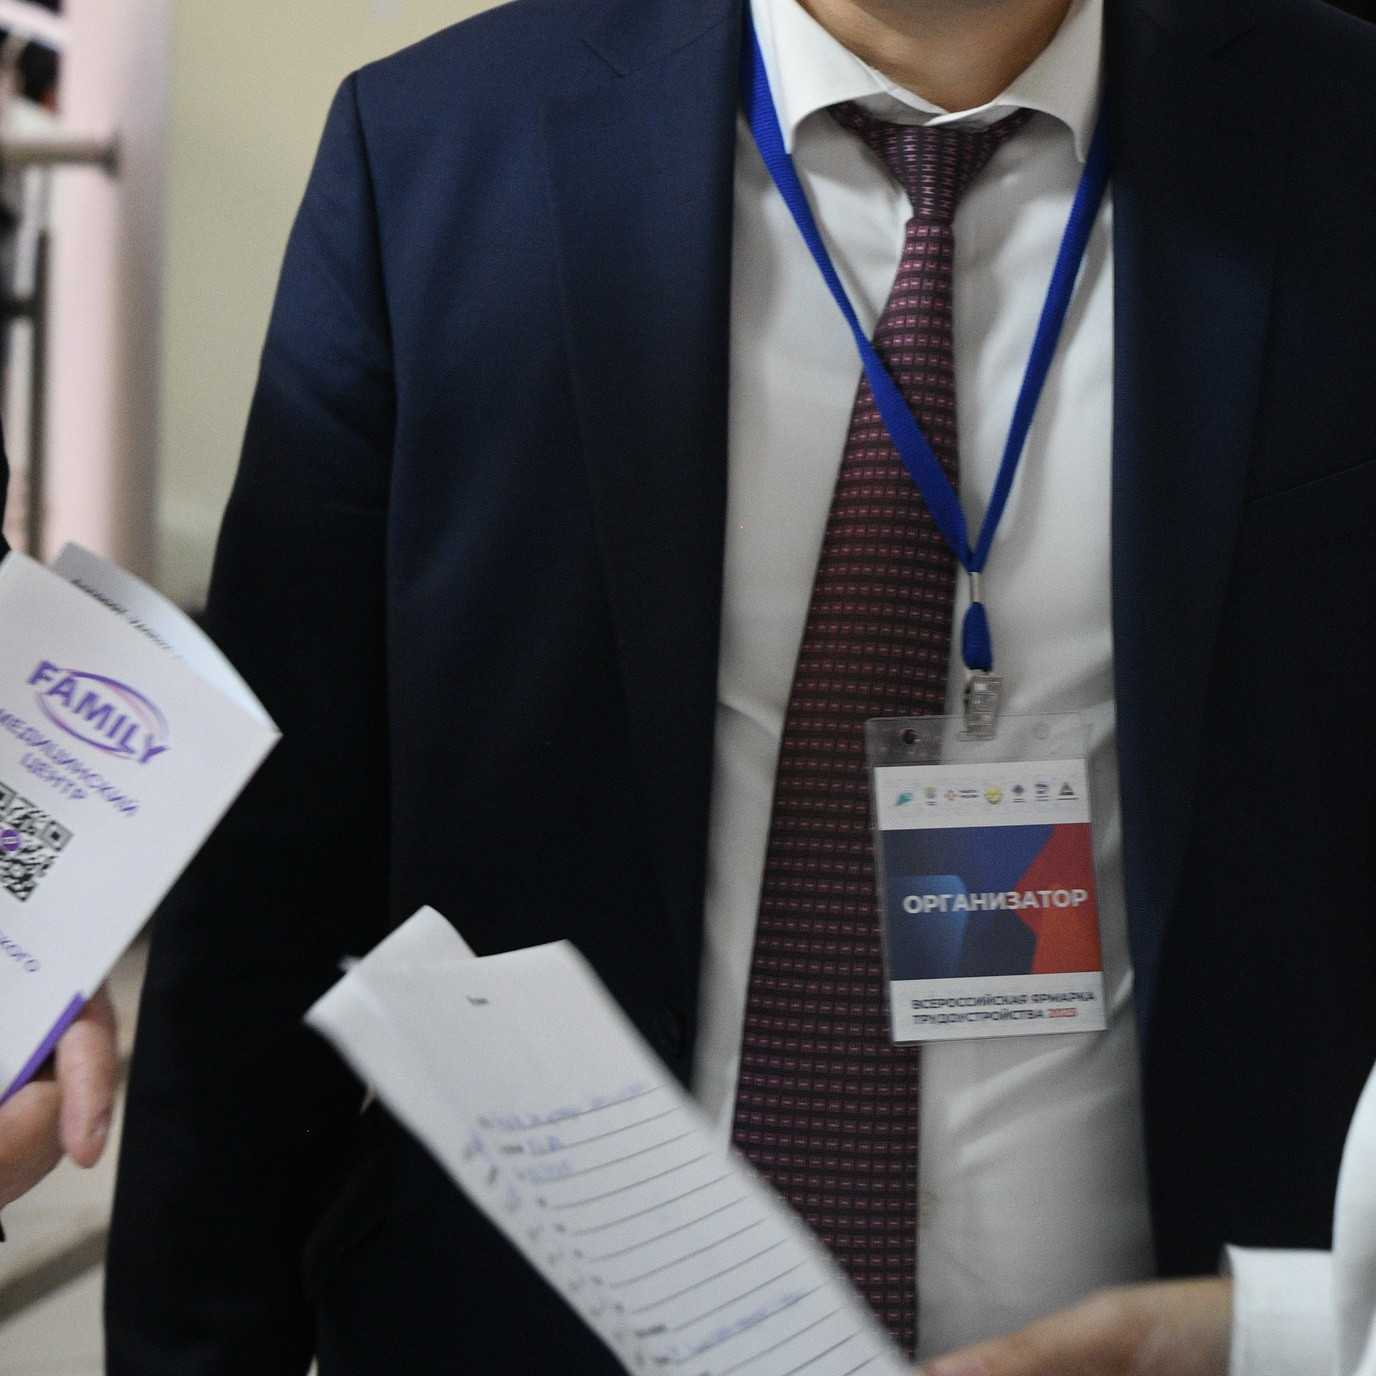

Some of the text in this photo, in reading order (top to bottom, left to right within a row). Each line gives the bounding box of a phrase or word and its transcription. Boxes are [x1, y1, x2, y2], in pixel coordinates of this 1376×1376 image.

[28, 660, 168, 763] FAMILY
[21, 752, 87, 800] ЦЕНТР
[902, 889, 1089, 915] ОРГАНИЗАТОР
[912, 991, 1095, 1010] ВСЕРОССИЙСКАЯ ЯРМАРКА
[912, 1008, 1044, 1025] ТРУДОУСТРОЙСТВА
